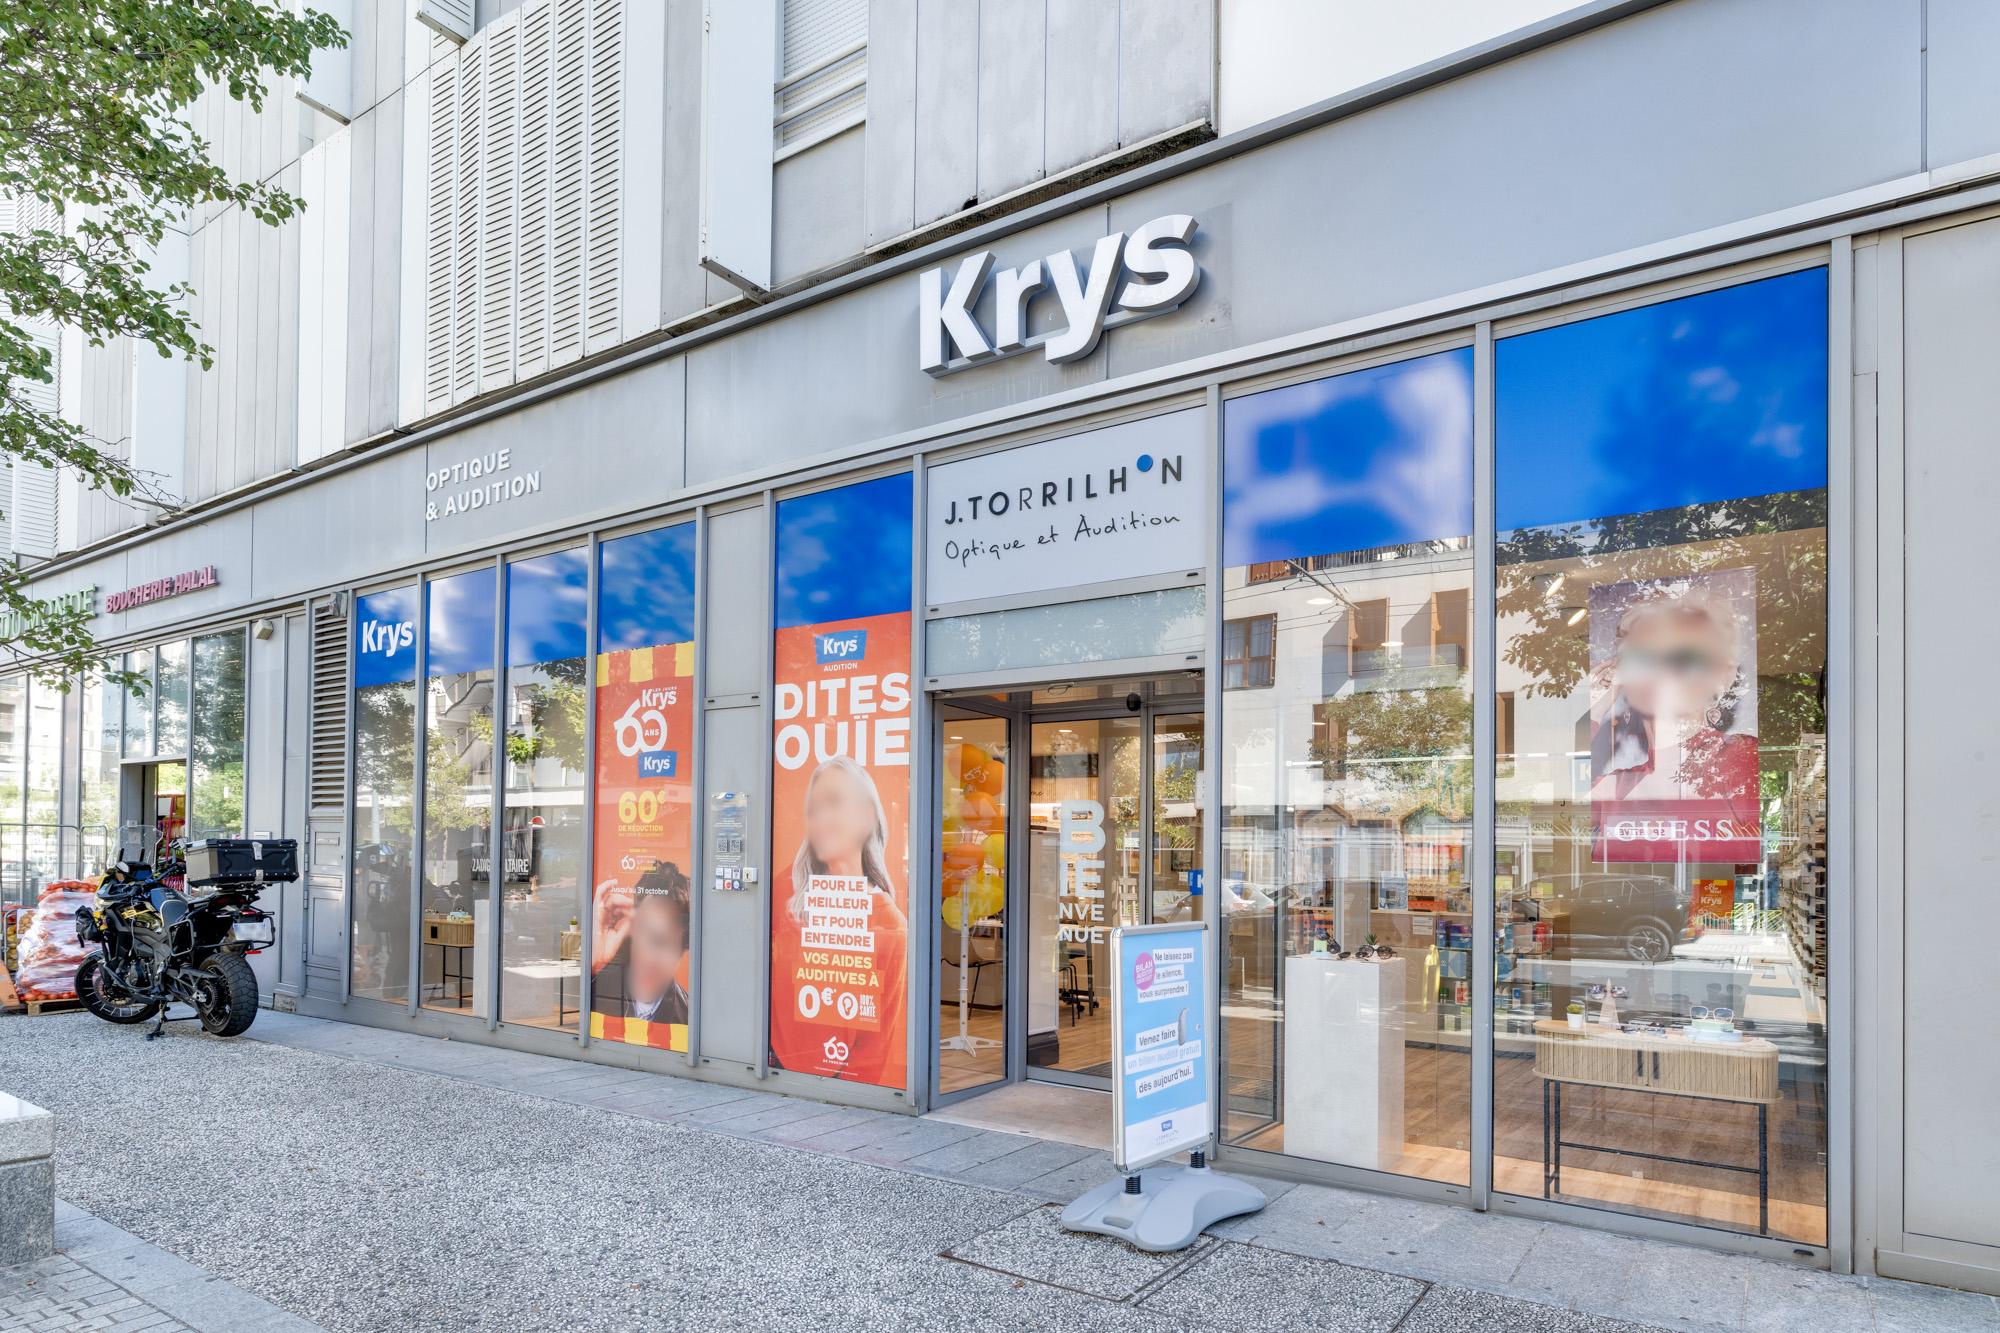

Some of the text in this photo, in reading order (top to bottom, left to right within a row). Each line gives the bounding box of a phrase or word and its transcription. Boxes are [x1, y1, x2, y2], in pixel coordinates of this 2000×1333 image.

[920, 214, 1199, 371] Krys
[426, 448, 510, 491] OPTIQUE
[426, 470, 540, 521] & AUDITION
[945, 511, 1181, 568] Optique et Audition
[106, 565, 217, 614] BOUCHERIE HALAL
[362, 620, 413, 657] Krys
[823, 637, 858, 656] Krys
[823, 662, 858, 672] AUDITION
[642, 689, 677, 710] Krys
[775, 673, 911, 720] DITES
[644, 728, 660, 736] ANS
[775, 715, 910, 770] OUÏE
[644, 757, 670, 772] Krys
[1615, 818, 1735, 842] GUESS
[645, 887, 669, 896] octobre
[812, 879, 864, 892] POUR LE
[807, 896, 869, 910] MEILLEUR
[1060, 902, 1105, 921] NVE
[812, 915, 864, 929] ET POUR
[804, 932, 871, 947] ENTENDRE
[1059, 926, 1105, 944] NUE
[803, 951, 872, 969] VOS AIDES
[1154, 951, 1193, 962] Ne laissez pas
[796, 967, 879, 987] AUDITIVES À
[1139, 991, 1153, 999] vous
[1155, 985, 1185, 998] surprendre
[1138, 1028, 1176, 1046] Venez faire
[1138, 1083, 1152, 1094] dès
